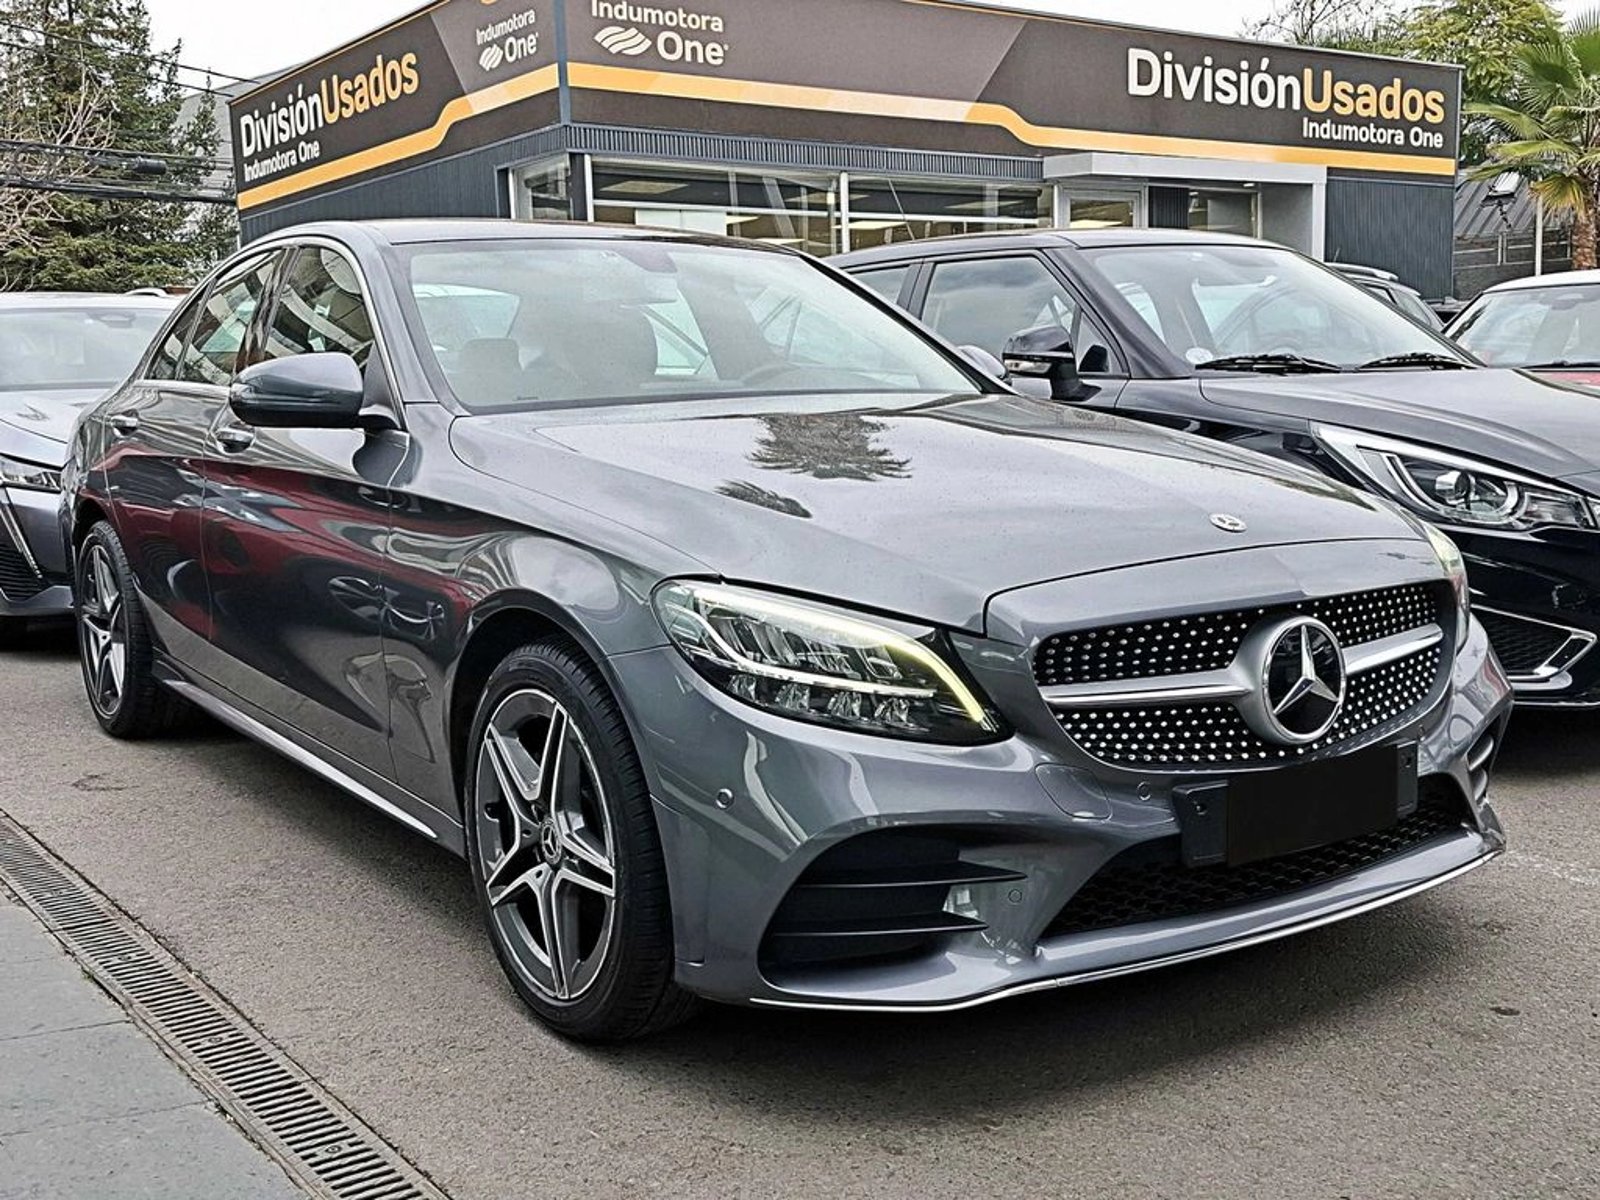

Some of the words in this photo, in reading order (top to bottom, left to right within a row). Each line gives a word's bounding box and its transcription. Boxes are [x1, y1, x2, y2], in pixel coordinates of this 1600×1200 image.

[476, 9, 535, 46] Indumotora
[591, 0, 723, 32] Indumotora
[505, 32, 537, 63] One
[656, 30, 725, 65] One
[1302, 116, 1403, 145] Indumotora
[1409, 126, 1443, 149] One
[243, 148, 297, 183] Indumotora
[298, 139, 320, 162] One
